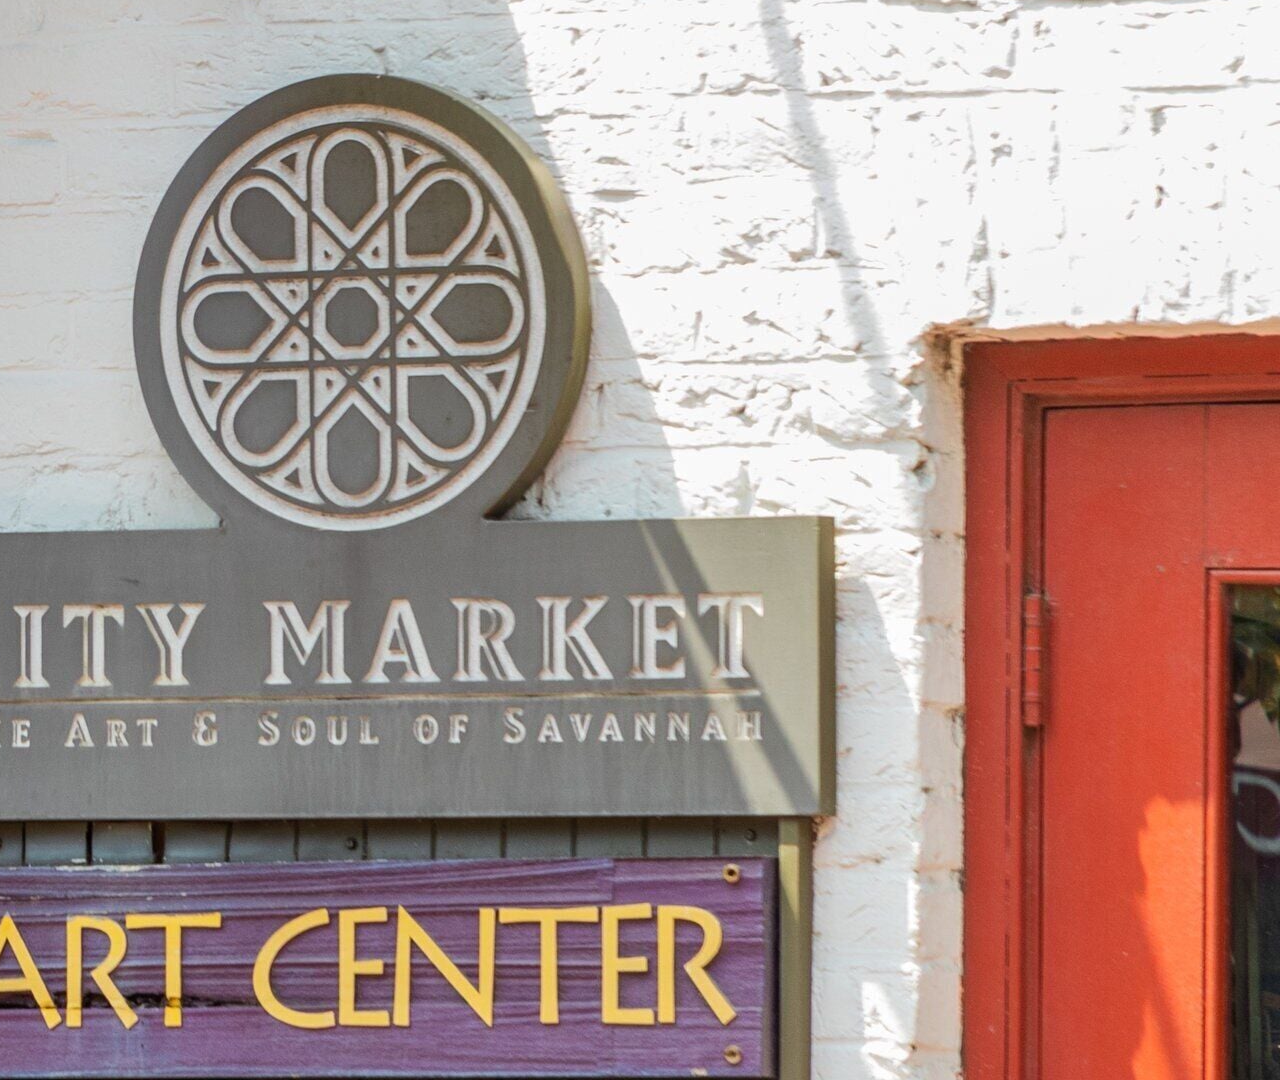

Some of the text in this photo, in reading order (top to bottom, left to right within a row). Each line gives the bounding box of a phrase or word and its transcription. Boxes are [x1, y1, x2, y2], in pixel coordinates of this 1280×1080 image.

[262, 592, 765, 685] MARKET
[192, 710, 218, 747] &
[413, 713, 469, 745] OF
[252, 902, 738, 1030] CENTER
